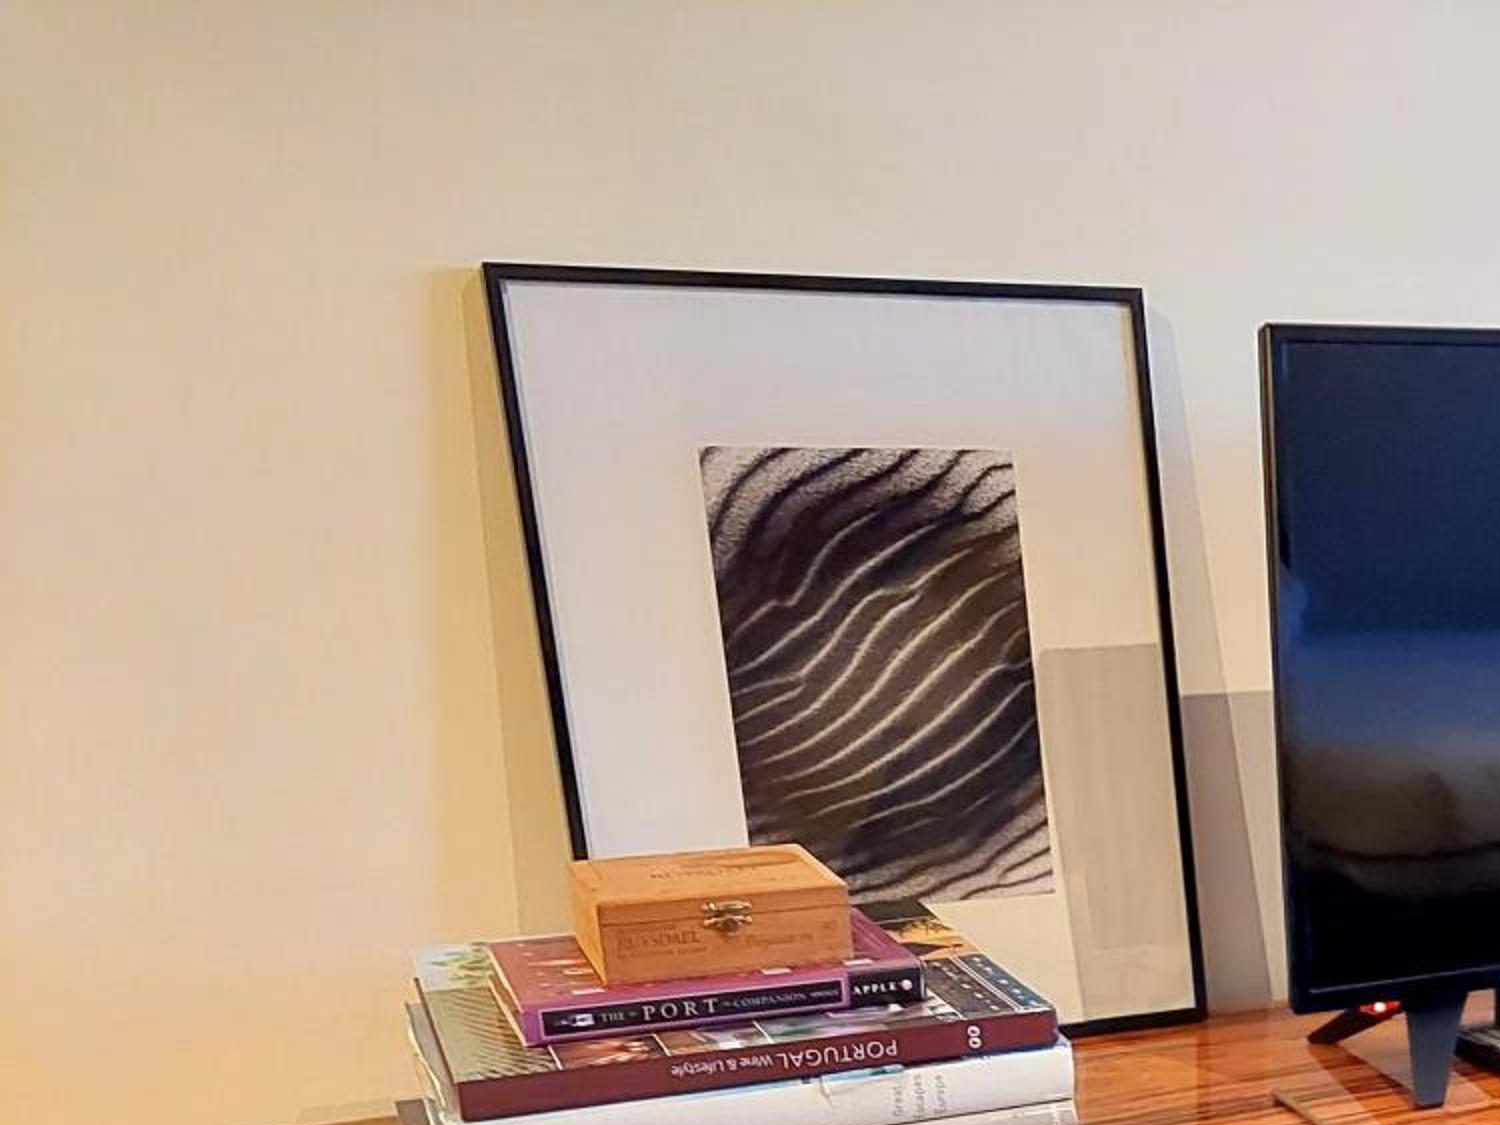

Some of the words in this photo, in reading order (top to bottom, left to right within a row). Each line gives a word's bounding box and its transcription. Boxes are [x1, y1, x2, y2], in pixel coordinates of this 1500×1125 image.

[853, 981, 897, 996] APPLE
[642, 996, 720, 1022] PORT
[776, 1040, 898, 1069] PORTUGAL
[670, 1060, 726, 1077] Lifestyle
[738, 1056, 774, 1071] Wine
